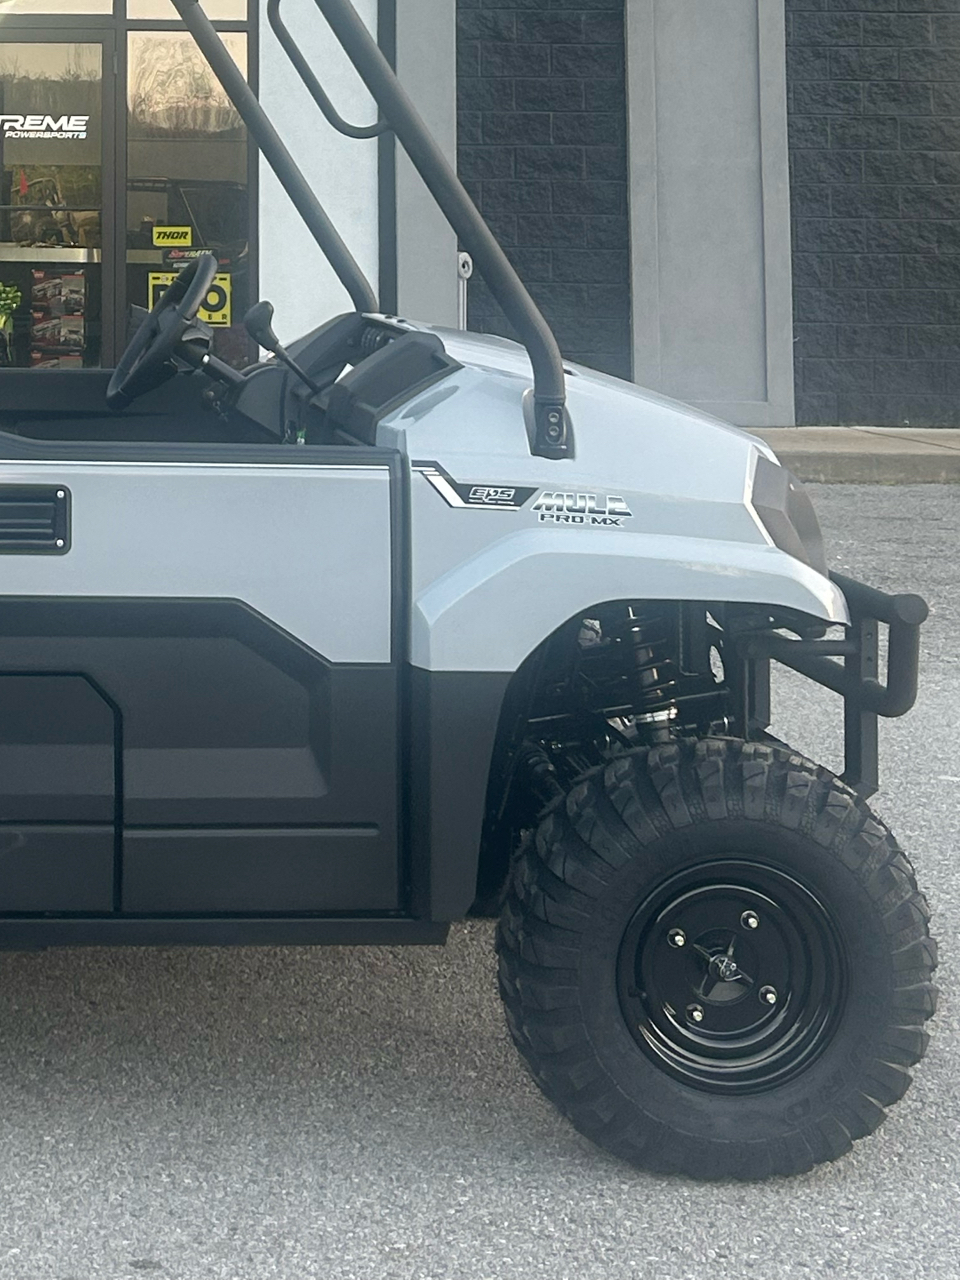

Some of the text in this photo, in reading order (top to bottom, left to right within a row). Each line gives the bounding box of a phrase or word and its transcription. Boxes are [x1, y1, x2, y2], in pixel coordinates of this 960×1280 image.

[5, 131, 87, 139] POWERSPORTS
[156, 231, 189, 239] THOR
[530, 491, 634, 517] MULE
